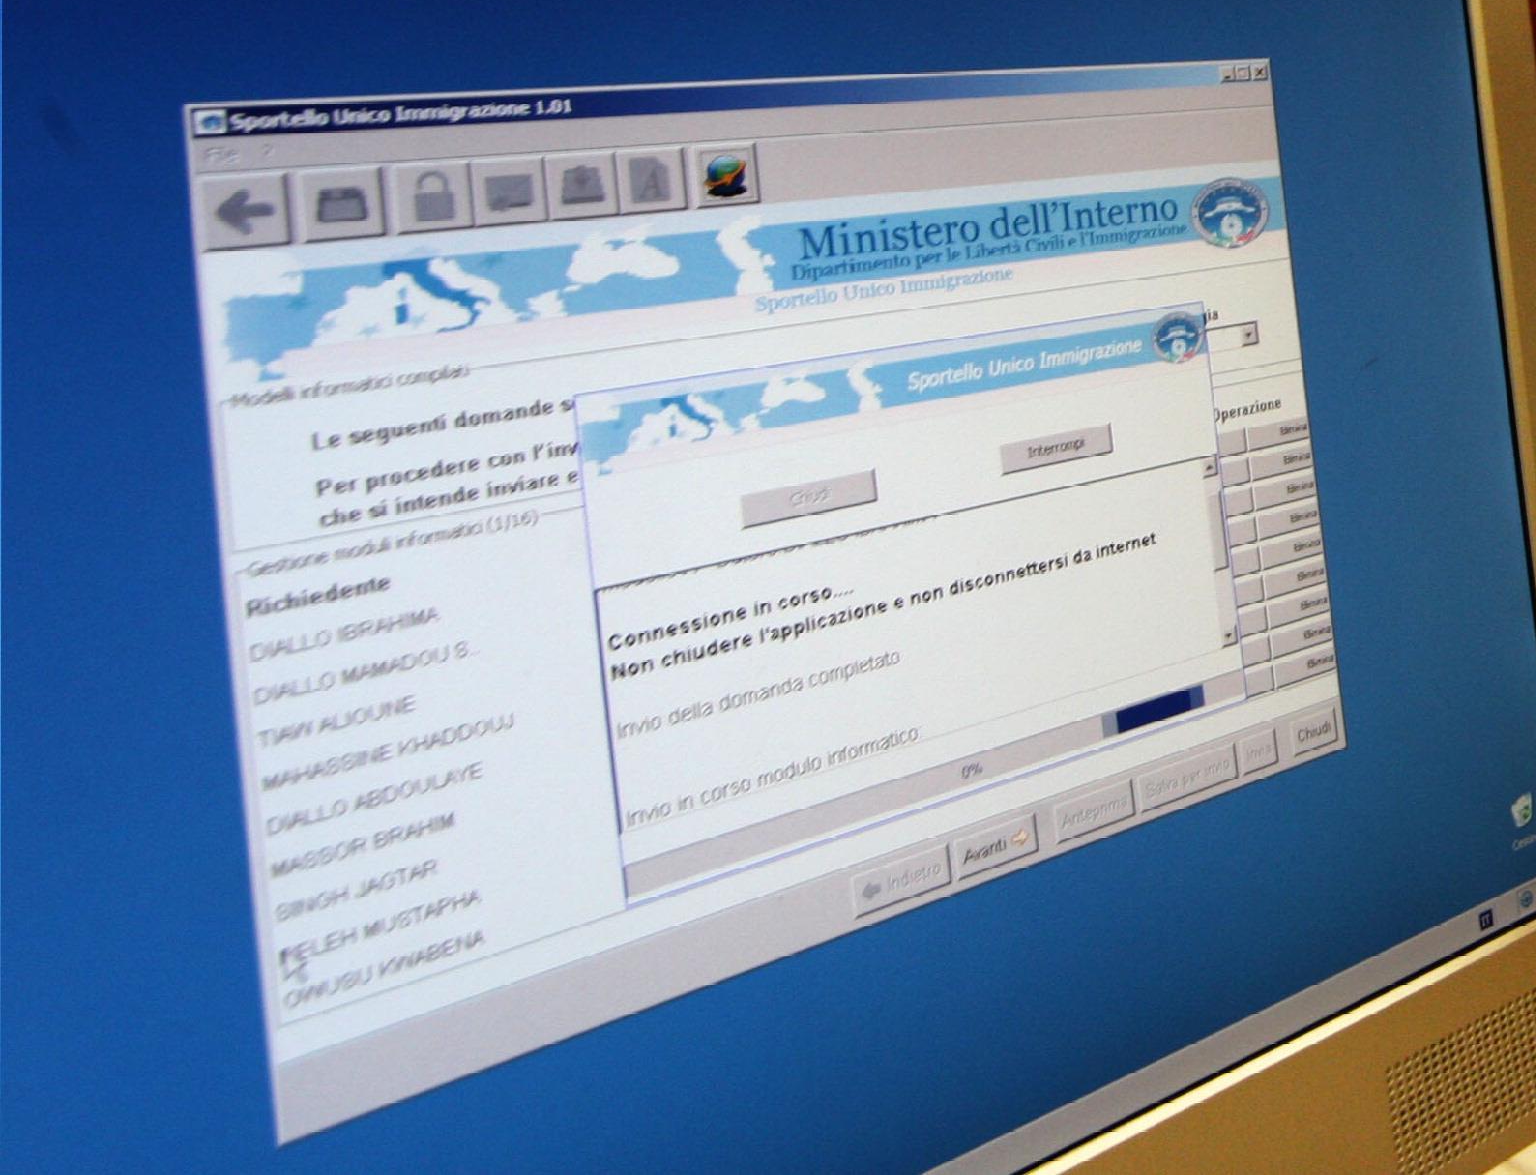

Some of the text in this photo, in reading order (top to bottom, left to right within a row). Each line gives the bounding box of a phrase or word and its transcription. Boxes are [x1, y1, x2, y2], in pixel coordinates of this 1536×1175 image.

[229, 99, 572, 133] Sportello Unico Immigrazione 1.01
[791, 222, 1188, 283] Dipartimento per le Libertà Civili e l'Immigrazione
[799, 198, 1179, 261] Ministero dell'Interno
[755, 268, 1014, 314] Sportello Unico Immigrazione
[908, 340, 1142, 394] Sportello Unico Immigrazione
[310, 431, 342, 452] Le
[348, 414, 447, 447] seguenti
[453, 398, 554, 429] domande
[315, 477, 358, 498] Per
[365, 457, 480, 495] procedere
[487, 450, 526, 468] con
[319, 507, 363, 529] che
[367, 498, 388, 518] si
[394, 485, 480, 516] intende
[486, 472, 559, 498] inviare
[246, 576, 392, 619] Richiedente
[610, 532, 1158, 682] Non chiudere l'applicazione e non disconnettersi da internet
[249, 607, 440, 663] DIALLO IBRAHIMA
[607, 603, 747, 652] Connessione
[753, 599, 772, 618] in
[253, 671, 337, 706] DIALLO
[341, 644, 451, 685] MAMADOU
[617, 649, 901, 740] Invio della domanda completato
[1297, 719, 1332, 744] Chiudi
[266, 760, 485, 838] DIALLO ABDOULAYE
[626, 726, 920, 827] Invio in corso modulo informatico
[963, 837, 1007, 866] Avanti
